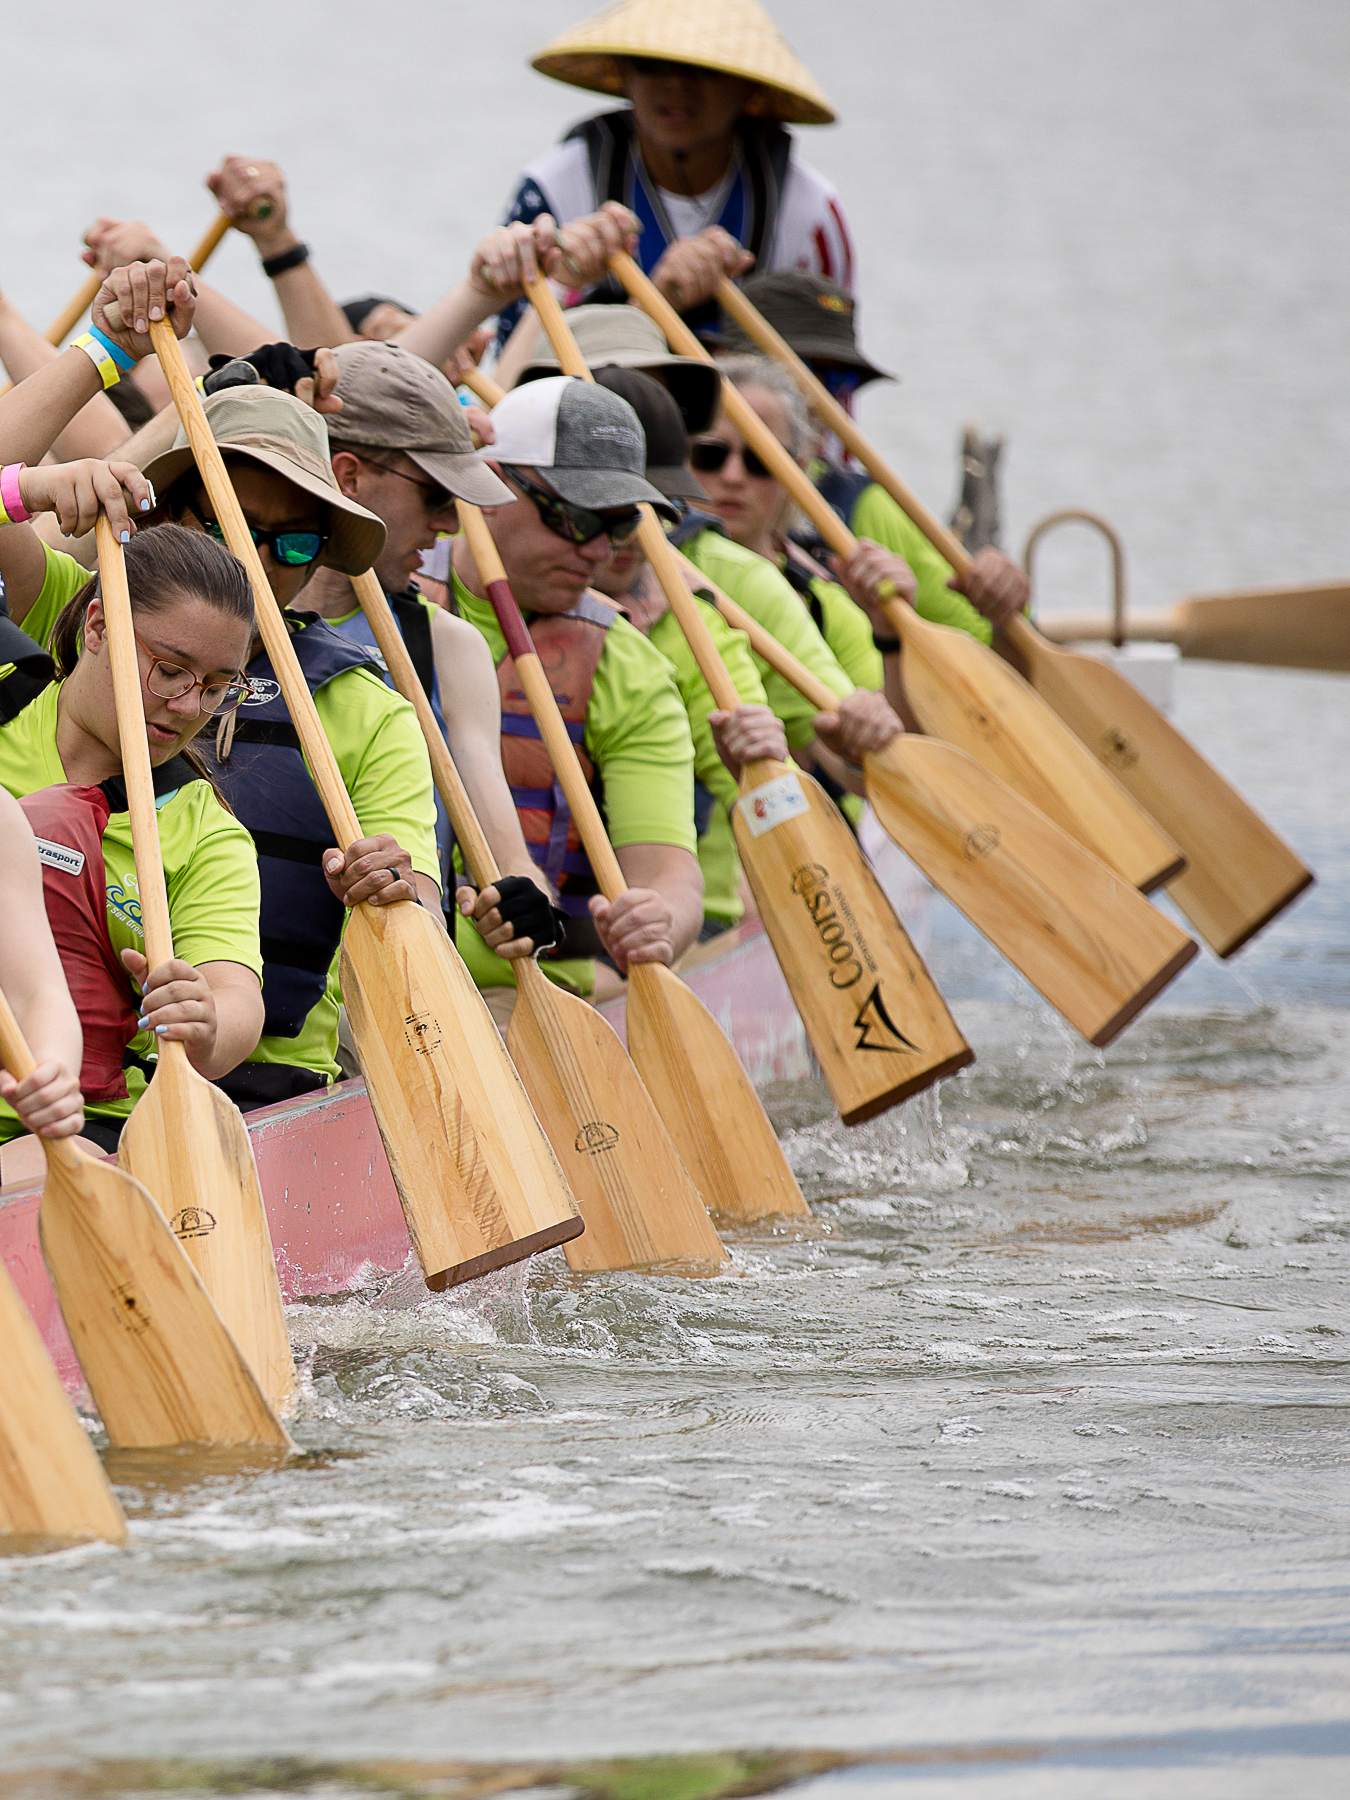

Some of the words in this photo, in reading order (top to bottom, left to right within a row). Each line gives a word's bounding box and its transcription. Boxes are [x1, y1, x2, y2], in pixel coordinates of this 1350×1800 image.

[38, 846, 80, 867] trasport
[110, 907, 127, 922] Sea
[810, 890, 863, 990] Coors
